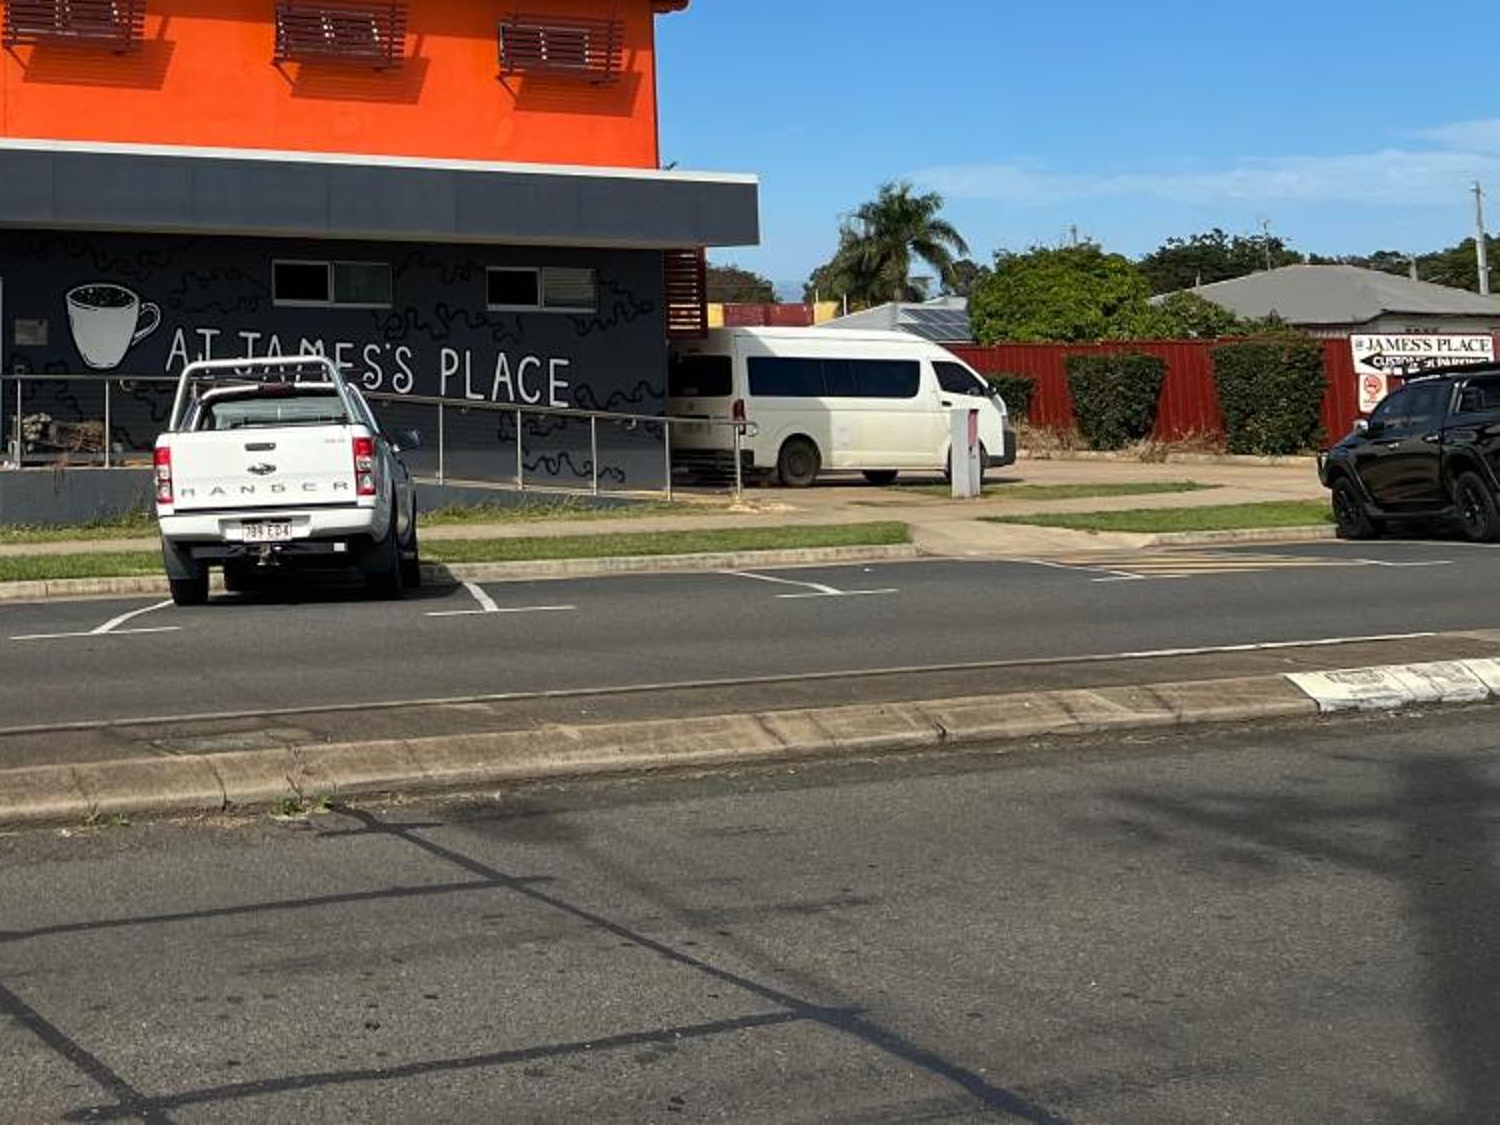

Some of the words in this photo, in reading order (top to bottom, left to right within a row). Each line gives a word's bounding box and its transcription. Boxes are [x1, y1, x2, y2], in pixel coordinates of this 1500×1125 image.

[1437, 338, 1491, 352] PLACE
[165, 327, 221, 379] AT
[234, 331, 413, 394] JAMES'S
[440, 348, 570, 408] PLACE
[181, 482, 349, 497] RANGER
